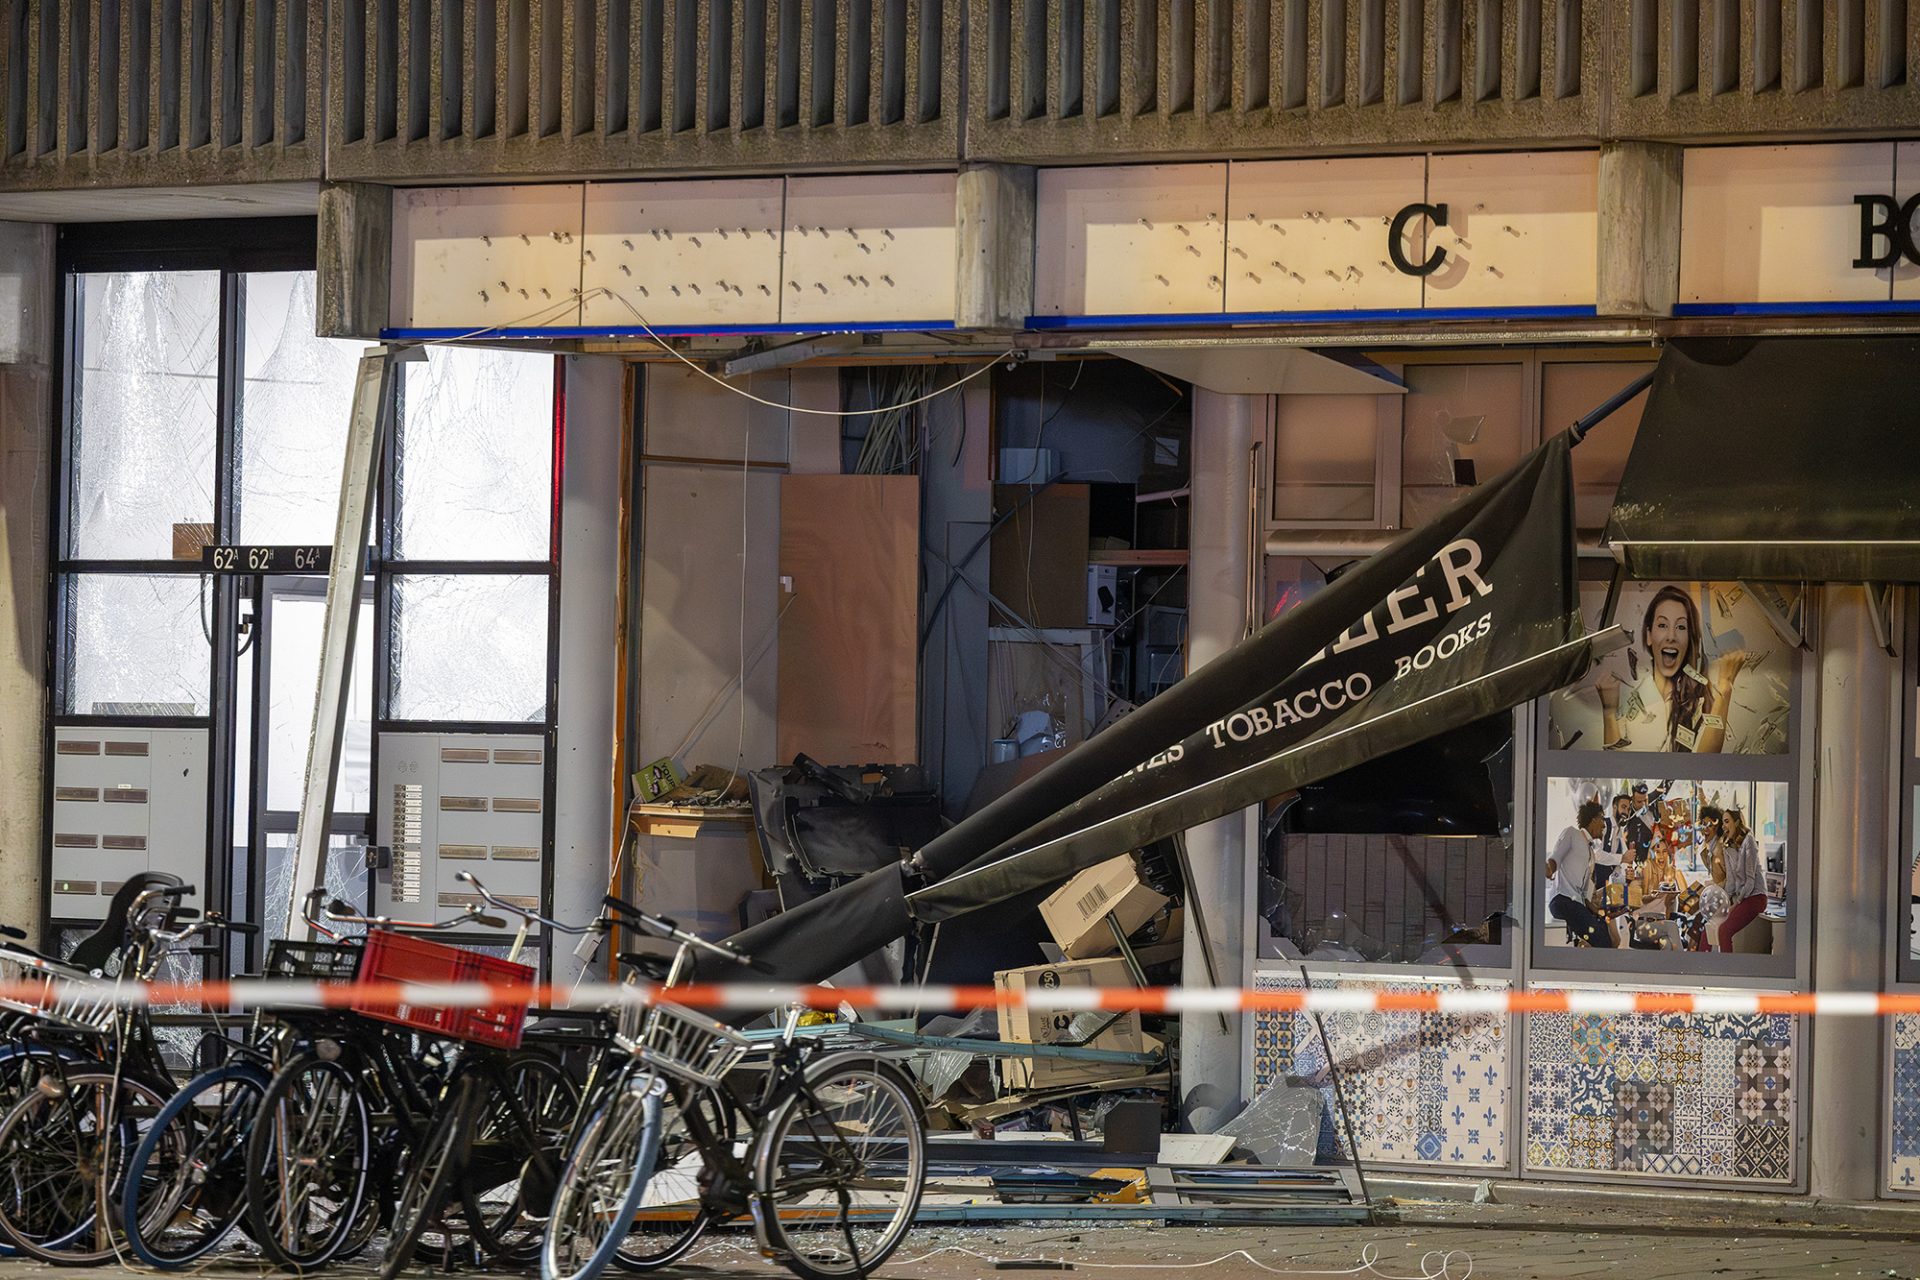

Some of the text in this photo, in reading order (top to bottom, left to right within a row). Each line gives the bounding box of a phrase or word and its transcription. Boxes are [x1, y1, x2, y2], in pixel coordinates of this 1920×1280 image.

[1388, 203, 1448, 277] C
[1206, 672, 1373, 750] TOBACCO
[1394, 612, 1493, 681] BOOKS
